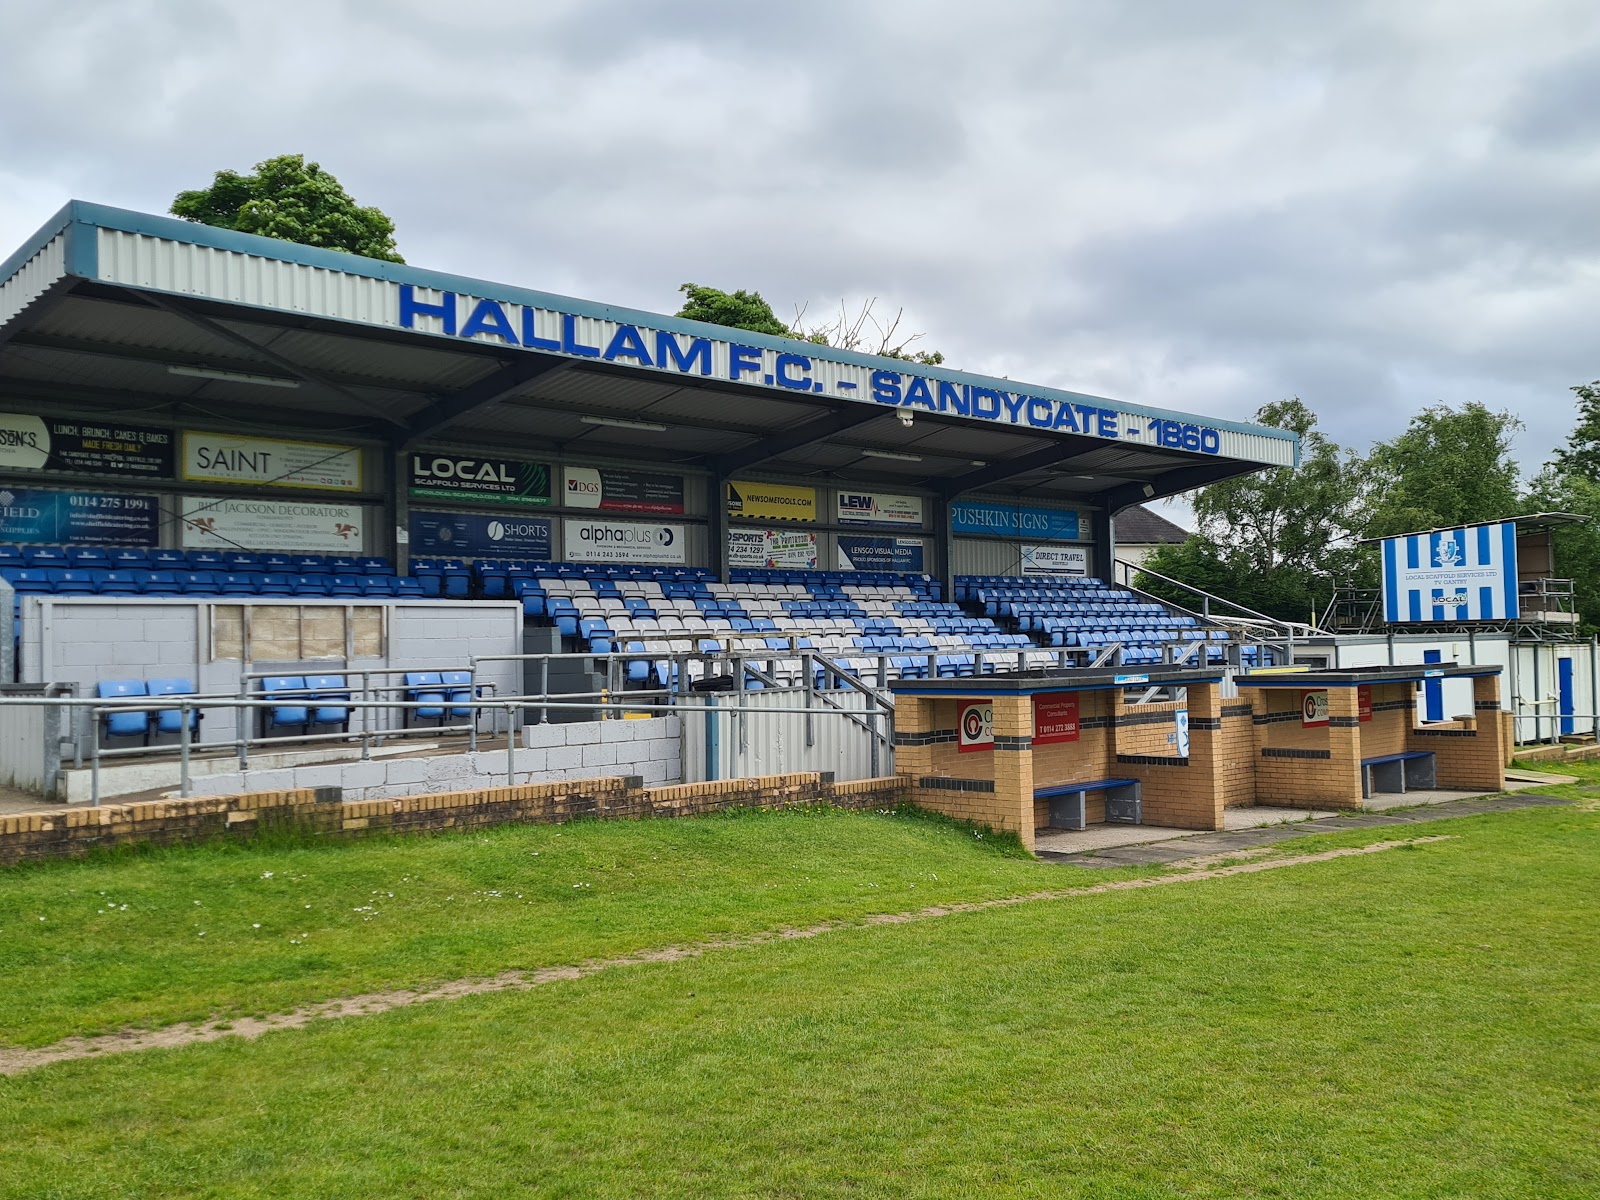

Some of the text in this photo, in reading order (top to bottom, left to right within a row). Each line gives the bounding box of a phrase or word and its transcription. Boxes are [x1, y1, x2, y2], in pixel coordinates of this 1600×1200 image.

[400, 284, 712, 377] HALLAM
[729, 342, 823, 392] F.C.
[837, 380, 857, 389] -
[871, 370, 1117, 439] SANDYGATE
[1148, 419, 1220, 455] 1860
[54, 424, 79, 439] LUNCH,
[82, 427, 112, 442] BRUNCH,
[114, 430, 136, 442] CAKES
[146, 432, 168, 445] BAKES
[82, 440, 101, 450] MADE
[102, 441, 123, 452] FRESH
[197, 446, 271, 474] SAINT
[413, 456, 516, 483] LOCAL
[414, 478, 516, 493] SCAFFOLD SERVICES LTD
[578, 481, 600, 494] DGS
[70, 495, 150, 511] 0114 275 1991
[746, 495, 812, 507] NEWSOMETOOLS.COM
[839, 494, 872, 509] LEW
[0, 506, 40, 519] IELD
[198, 501, 223, 513] BILL
[225, 503, 276, 516] JACKSON
[278, 505, 350, 519] DECORATORS
[1011, 512, 1049, 530] SIGNS
[504, 523, 548, 538] SHORTS
[580, 525, 652, 545] alphaplus
[735, 545, 748, 554] 234
[749, 546, 764, 555] 1297
[875, 547, 894, 556] VISUAL
[894, 548, 913, 557] MEDIA
[1035, 551, 1085, 563] DIRECT TRAVEL
[1425, 572, 1456, 580] SCAFFOLD
[1456, 571, 1485, 579] SERVICES
[1432, 596, 1466, 604] LOCAL
[1061, 701, 1076, 710] Property
[1047, 710, 1068, 718] Consultants
[1043, 725, 1054, 733] 0114
[1056, 724, 1065, 732] 272
